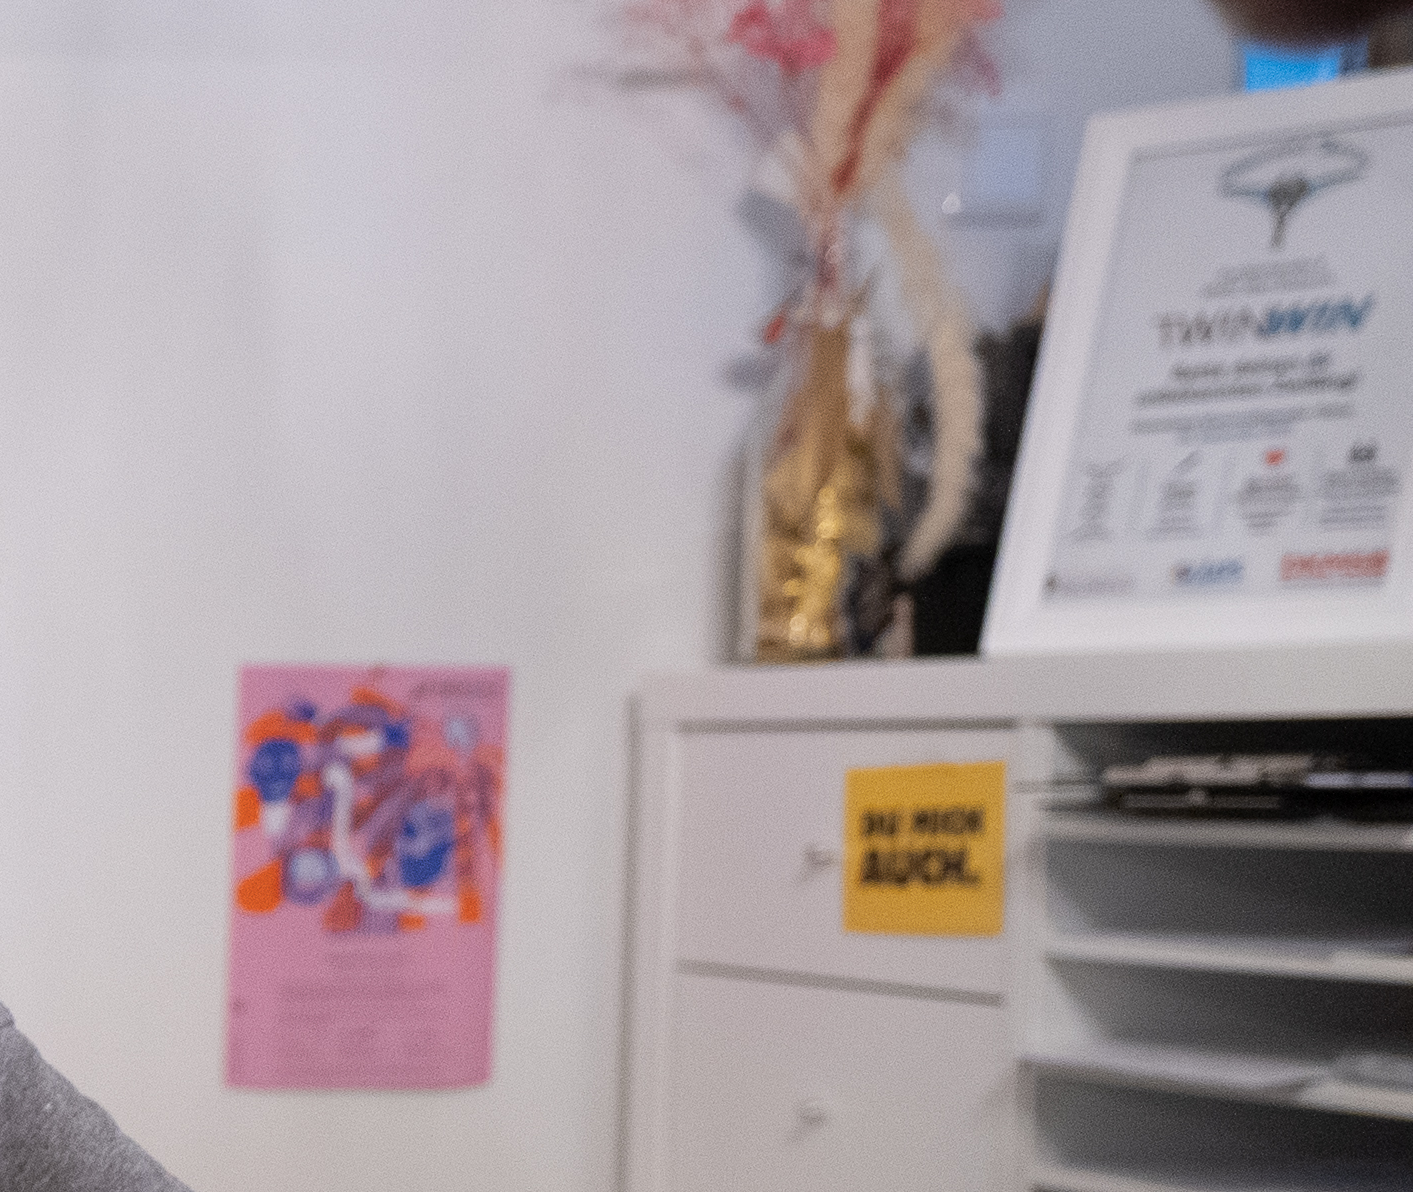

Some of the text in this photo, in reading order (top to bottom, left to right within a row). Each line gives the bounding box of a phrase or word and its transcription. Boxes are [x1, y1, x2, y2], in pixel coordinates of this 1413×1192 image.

[860, 807, 985, 837] DU MICH
[860, 848, 981, 886] AUCH.
